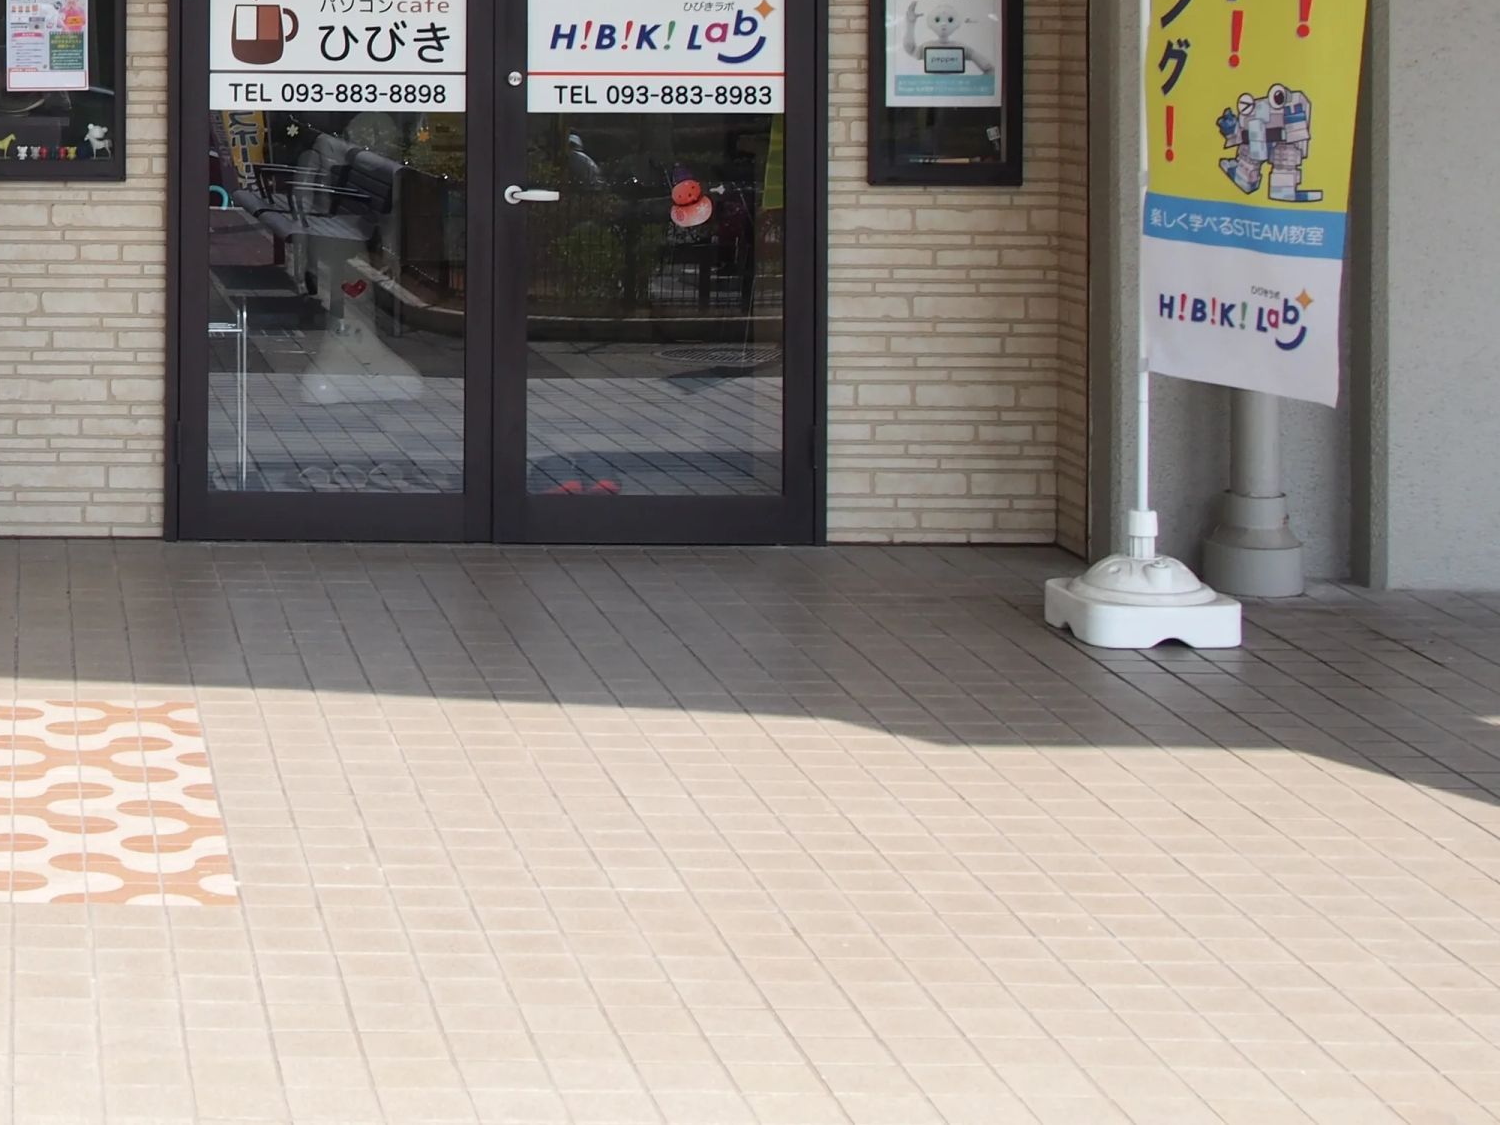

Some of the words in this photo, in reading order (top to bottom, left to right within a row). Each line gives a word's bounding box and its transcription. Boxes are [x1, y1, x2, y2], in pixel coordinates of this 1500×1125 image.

[683, 1, 735, 14] ひびきラボ
[318, 21, 452, 65] ひびき
[550, 20, 677, 51] H!B!K!
[686, 8, 759, 51] Lab
[228, 83, 272, 104] TEL
[280, 83, 447, 105] 093-883-8898
[554, 85, 597, 106] TEL
[606, 85, 773, 107] 093-883-8983
[1150, 207, 1324, 246] 楽しく学べるSTEAM教室
[1159, 293, 1248, 330] H!B!K!
[1256, 298, 1300, 333] Lab
